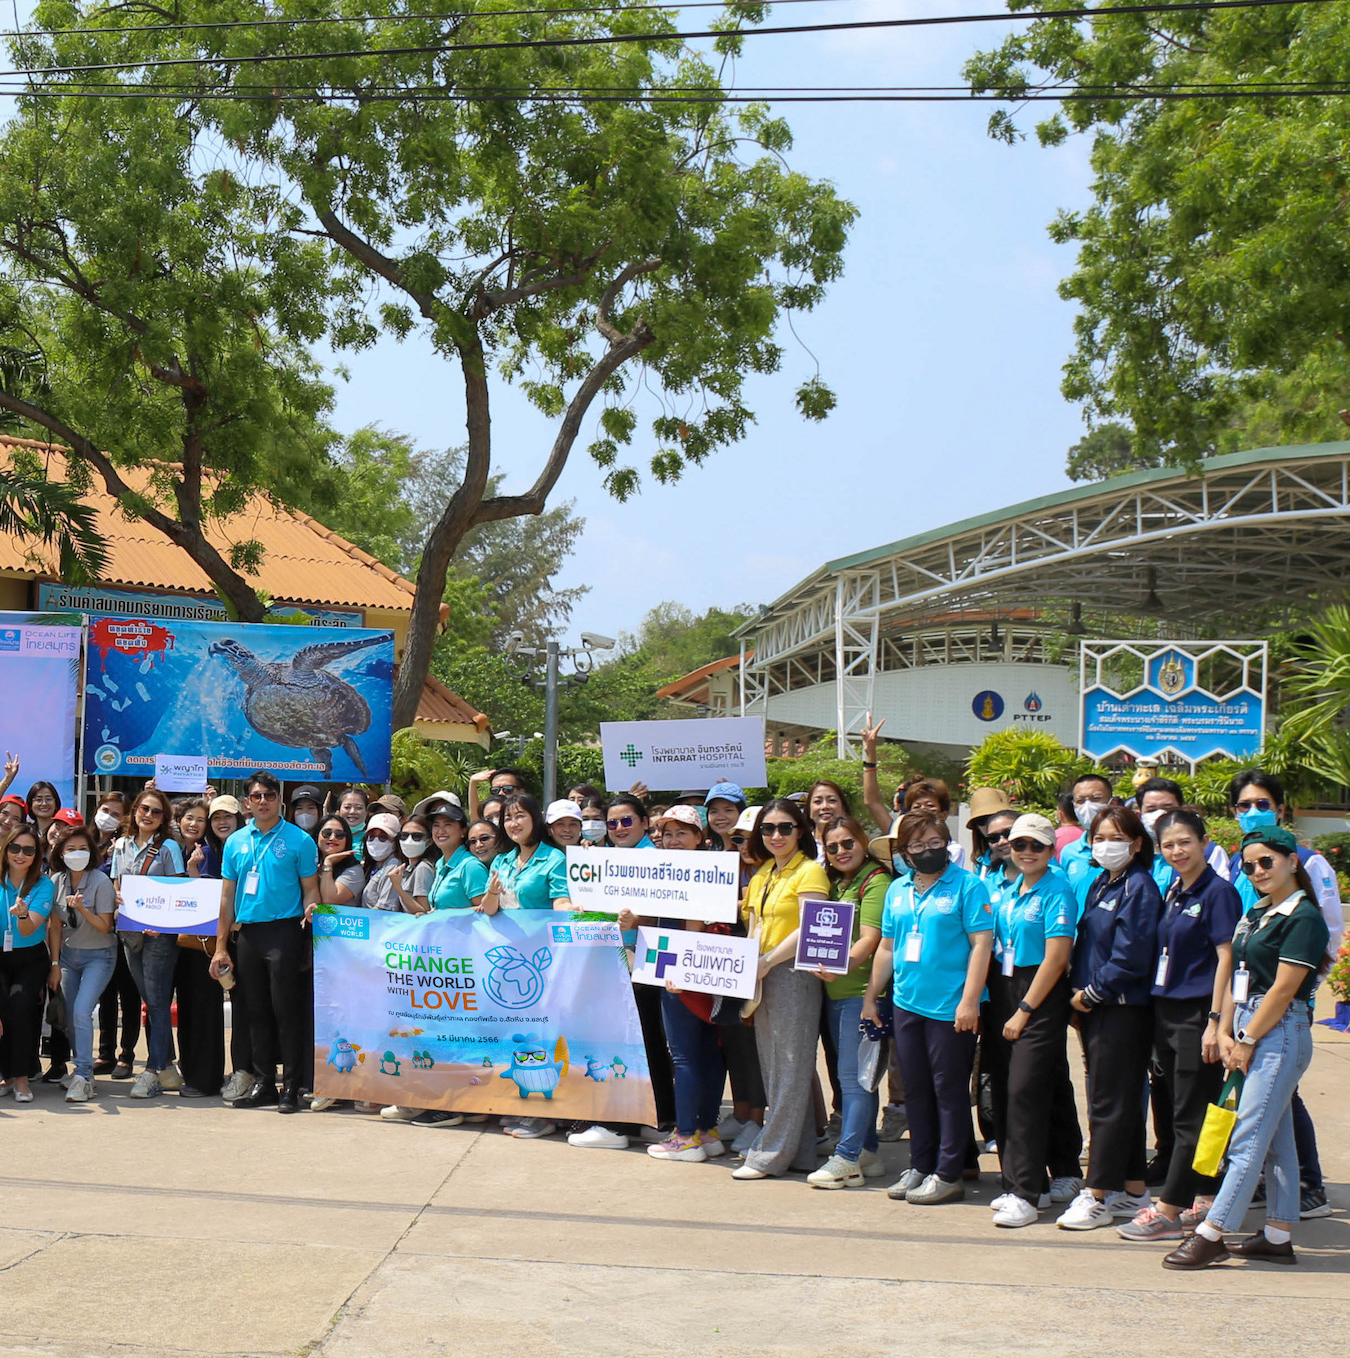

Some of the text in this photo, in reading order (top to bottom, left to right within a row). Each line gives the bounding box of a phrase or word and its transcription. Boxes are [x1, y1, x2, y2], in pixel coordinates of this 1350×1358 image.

[26, 638, 76, 653] ไทยสมุทร
[1096, 701, 1248, 714] บ้านเต่าทะเล เฉลิมพระเกียรติ
[651, 742, 742, 755] โรงพยาบาล อินทรารัตน์
[126, 755, 156, 765] ลดการ
[653, 752, 745, 763] INTRARAT HOSPITAL
[173, 764, 204, 773] พญาไท
[569, 859, 734, 885] CGH โรงพยาบาลซีจีเอช สายไหม
[604, 885, 688, 901] CGH SAIMAI HOSPITAL
[146, 896, 165, 904] เปาโล
[340, 917, 363, 927] LOVE
[576, 932, 619, 942] ไทยสมุทร
[385, 942, 442, 955] OCEAN LIFE
[697, 941, 733, 954] โรงพยาบาล
[385, 953, 474, 974] CHANGE
[682, 950, 745, 974] สินแพทย์
[386, 972, 475, 989] THE WORLD
[684, 972, 738, 990] รามอินทรา
[387, 986, 478, 1011] WITH LOVE
[437, 1034, 446, 1042] 15
[449, 1034, 475, 1043] มีนาคม
